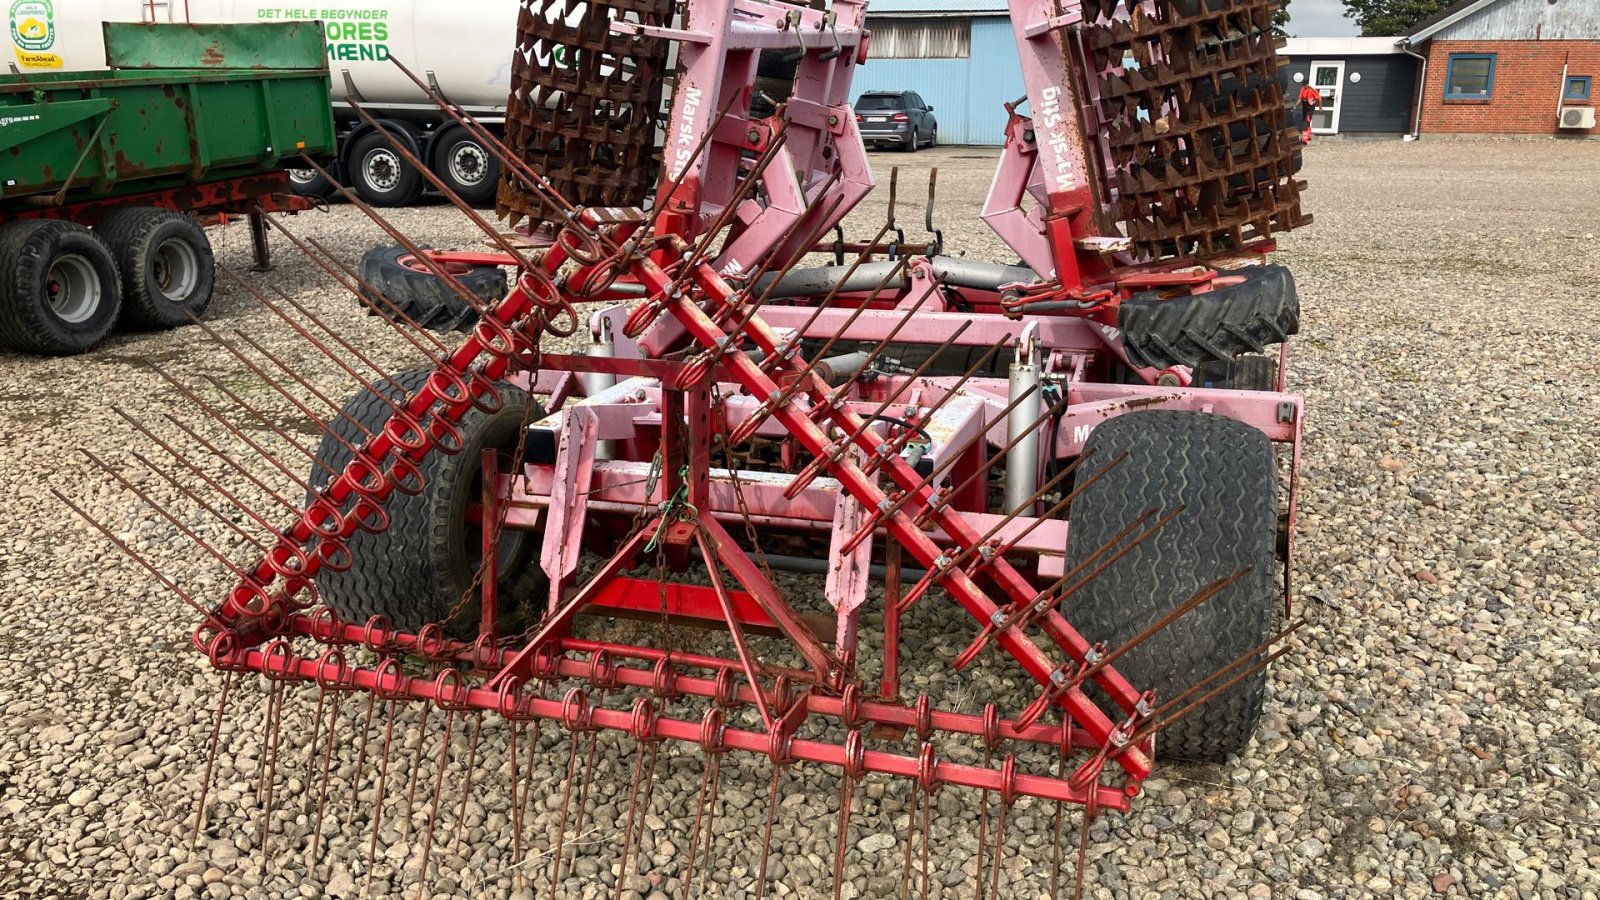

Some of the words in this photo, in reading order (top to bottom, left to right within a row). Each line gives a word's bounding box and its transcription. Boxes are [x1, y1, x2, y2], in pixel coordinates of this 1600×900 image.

[258, 9, 281, 18] DET
[285, 9, 317, 19] HELE
[321, 10, 388, 20] BEGYNDER
[678, 86, 702, 147] Marsk
[1041, 85, 1062, 129] Stig
[1048, 132, 1077, 192] Marsk
[1074, 424, 1095, 443] M
